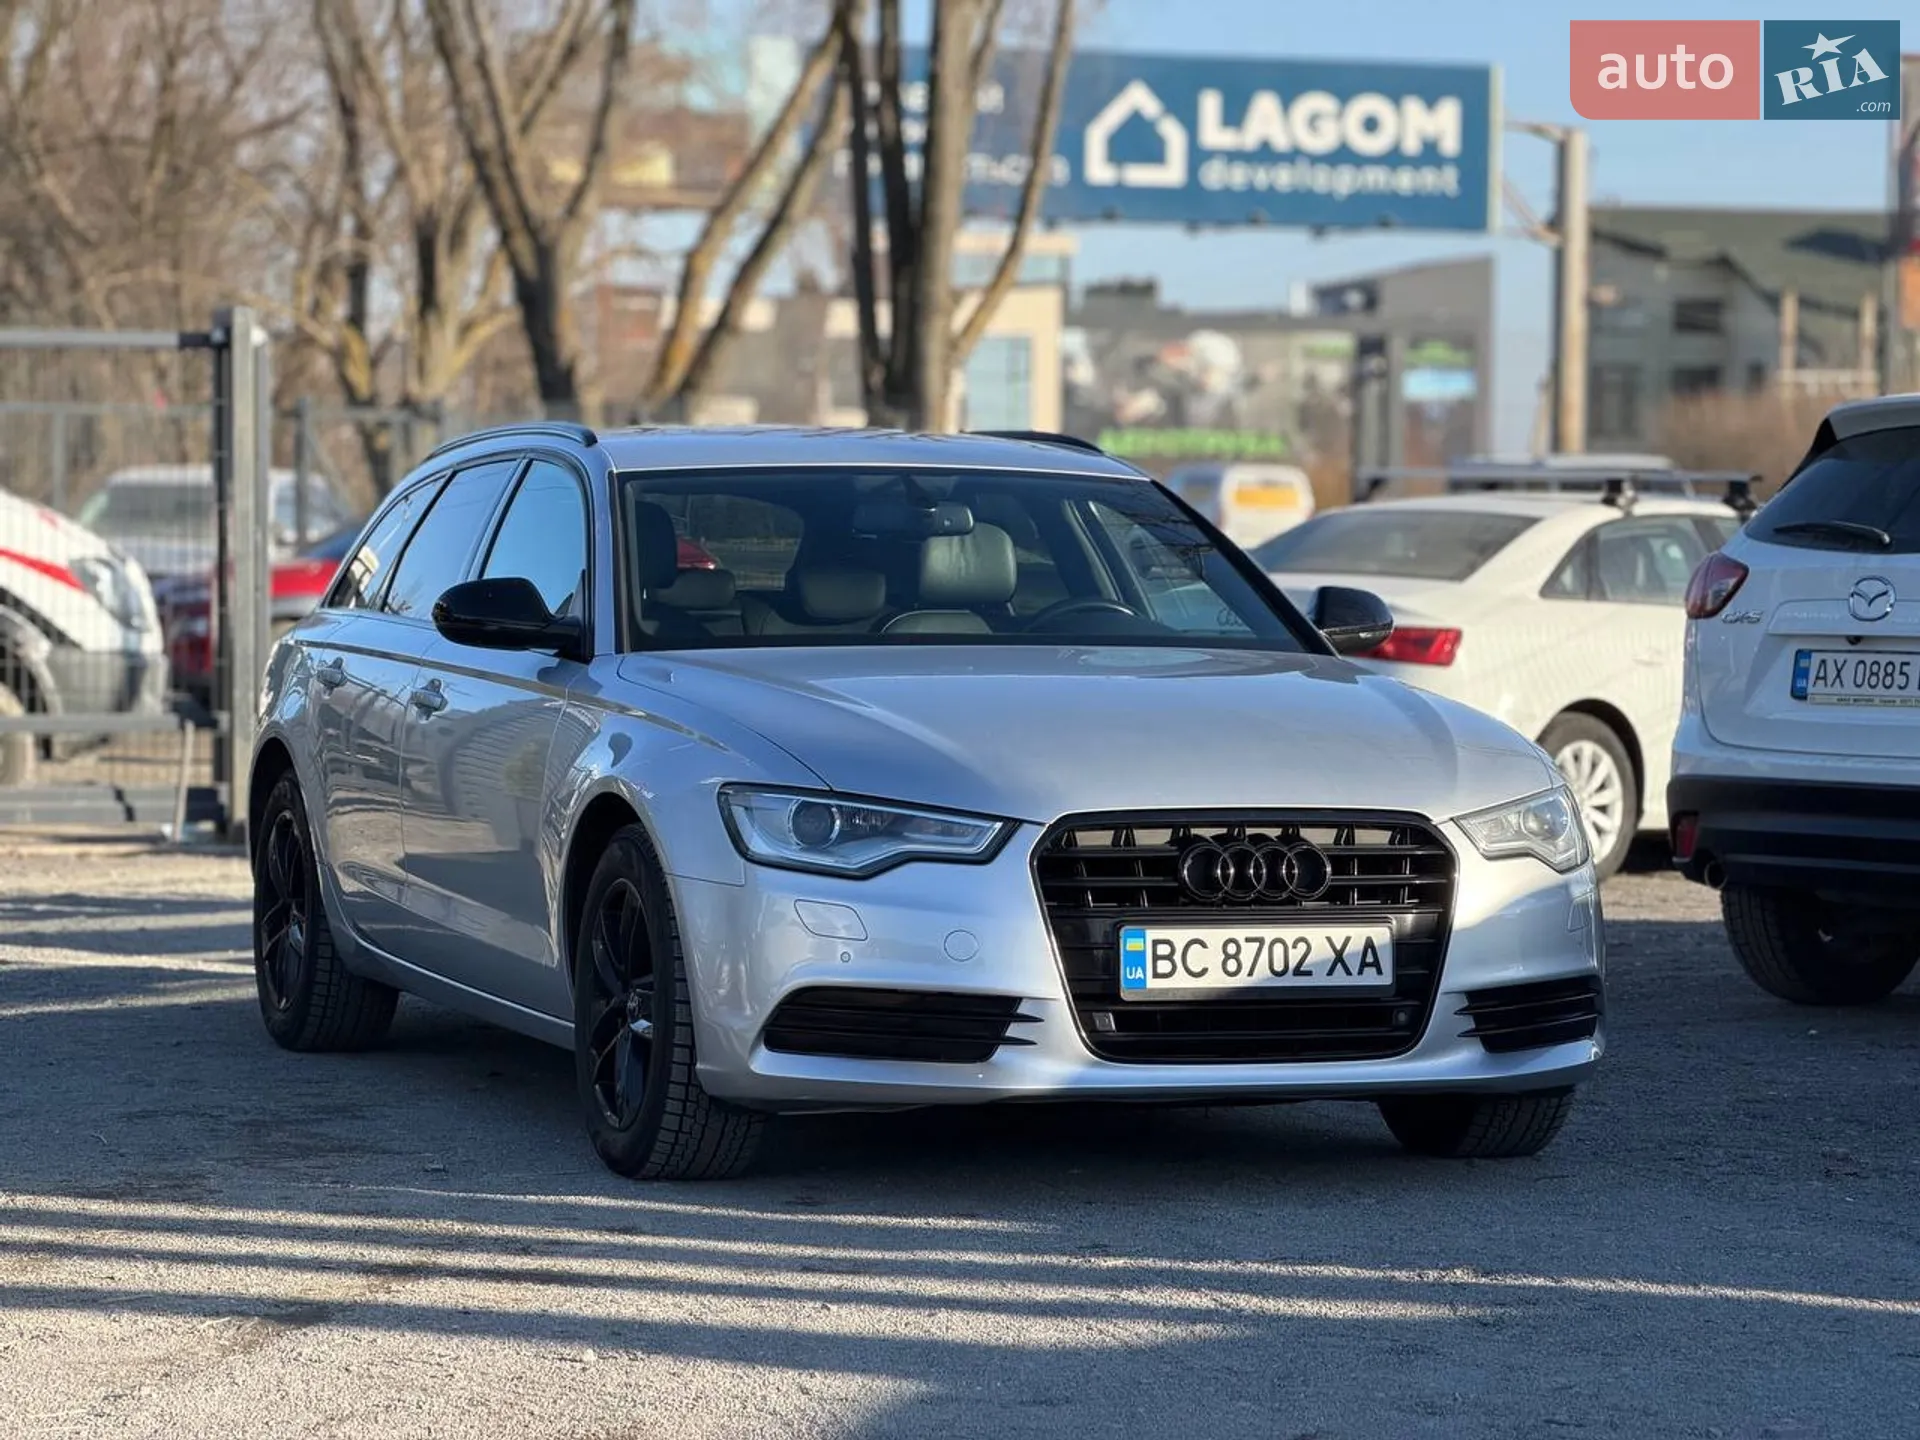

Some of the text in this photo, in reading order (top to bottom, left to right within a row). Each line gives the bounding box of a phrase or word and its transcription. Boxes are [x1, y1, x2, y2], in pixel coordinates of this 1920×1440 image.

[1197, 86, 1463, 158] LAGOM
[1198, 154, 1461, 200] development
[1812, 658, 1911, 690] AX 0885
[1126, 966, 1144, 980] UA
[1151, 935, 1384, 980] BC 8702 XA
